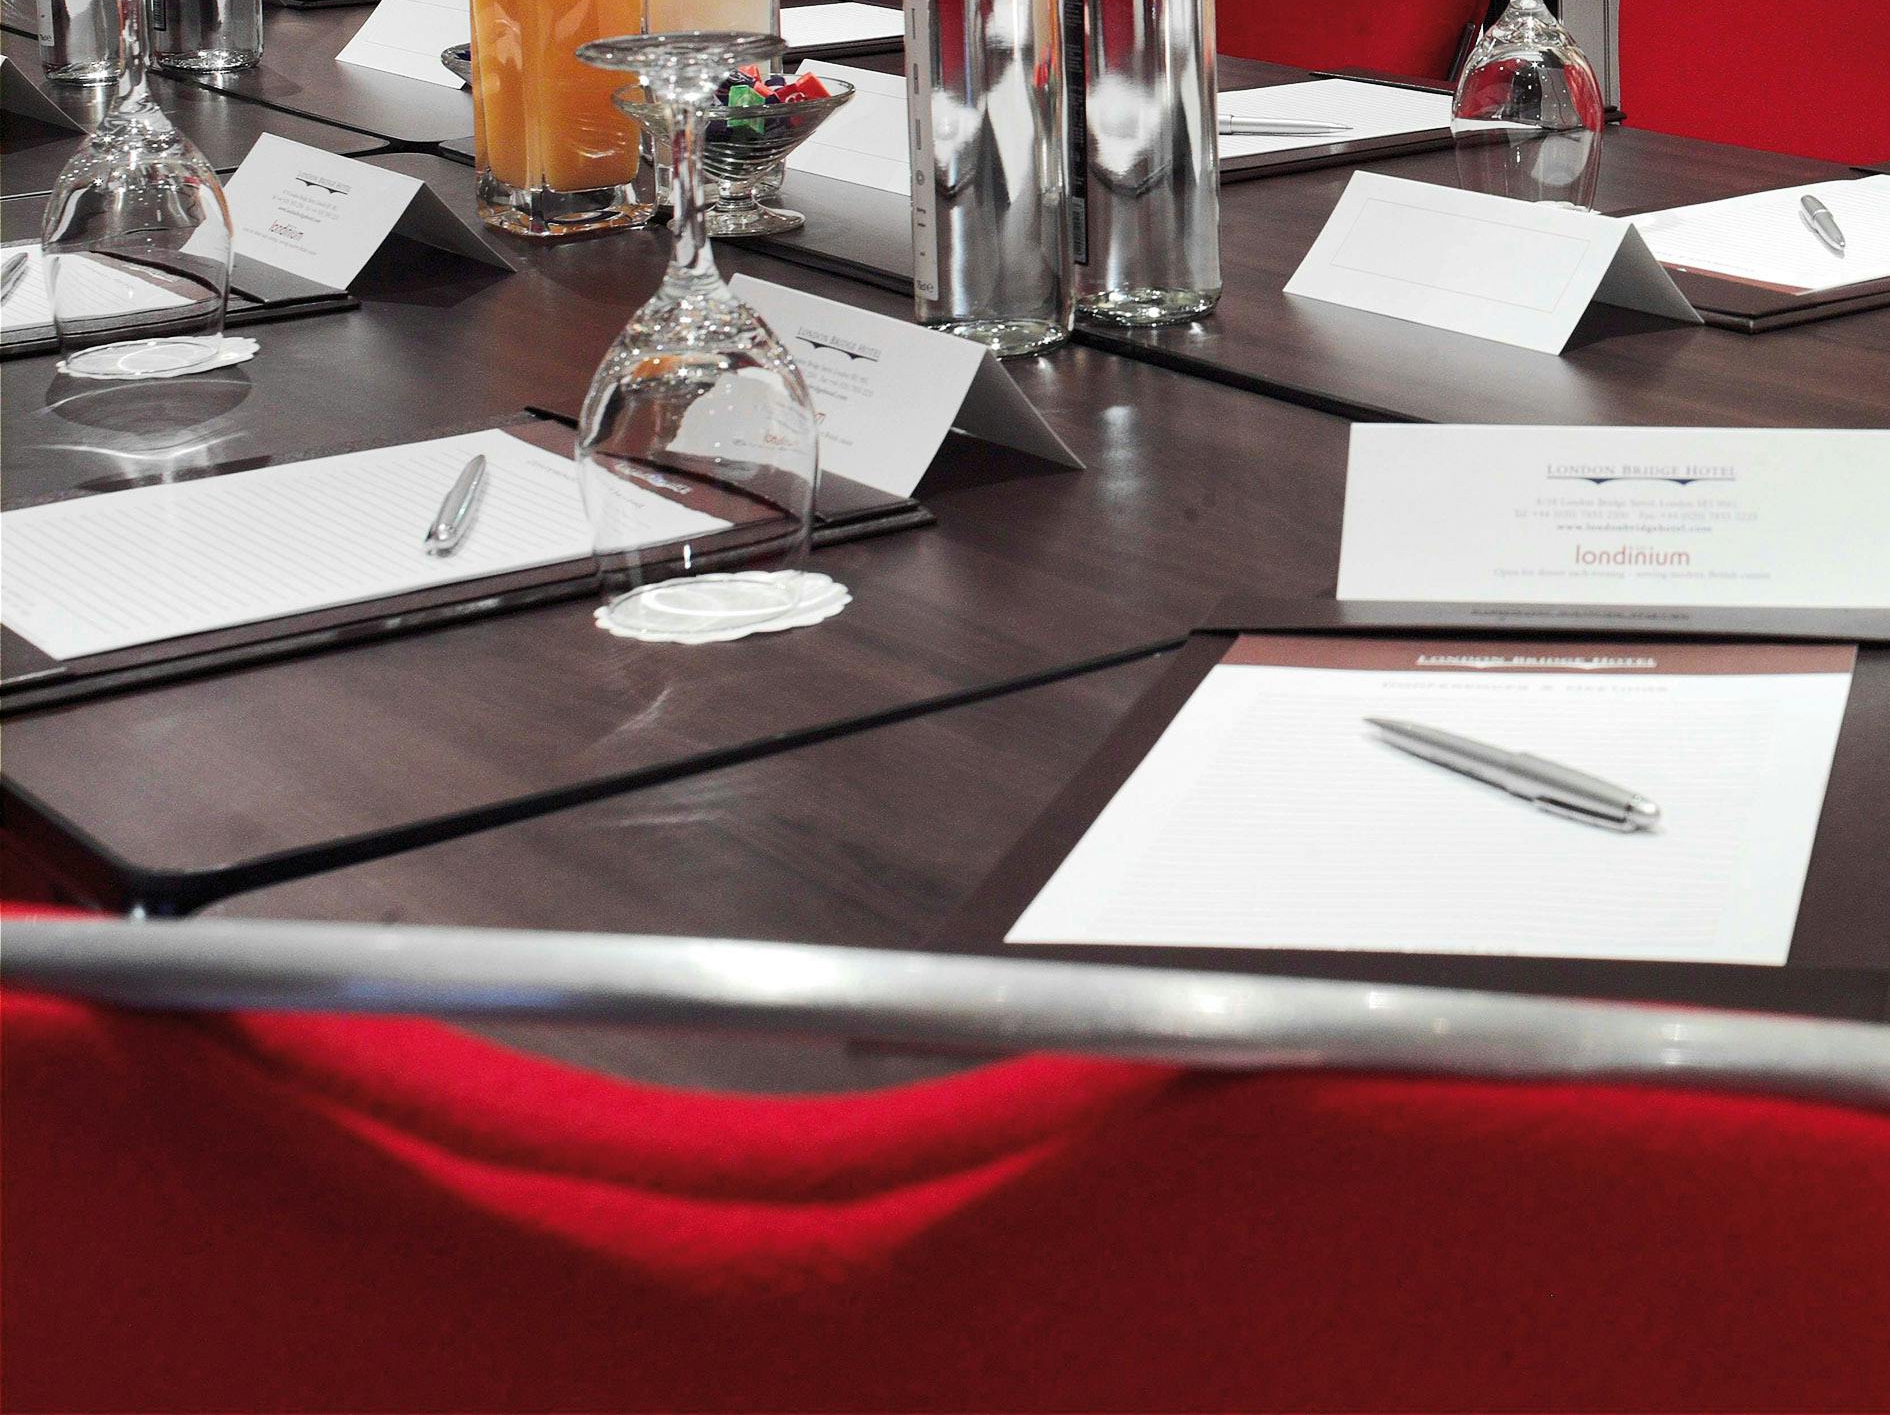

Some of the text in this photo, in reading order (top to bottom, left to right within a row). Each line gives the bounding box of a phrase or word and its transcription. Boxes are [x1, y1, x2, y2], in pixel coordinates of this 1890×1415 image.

[797, 327, 828, 341] LONDON
[1547, 463, 1737, 476] LONDON BRIDGE HOTEL
[1575, 544, 1690, 567] londinium
